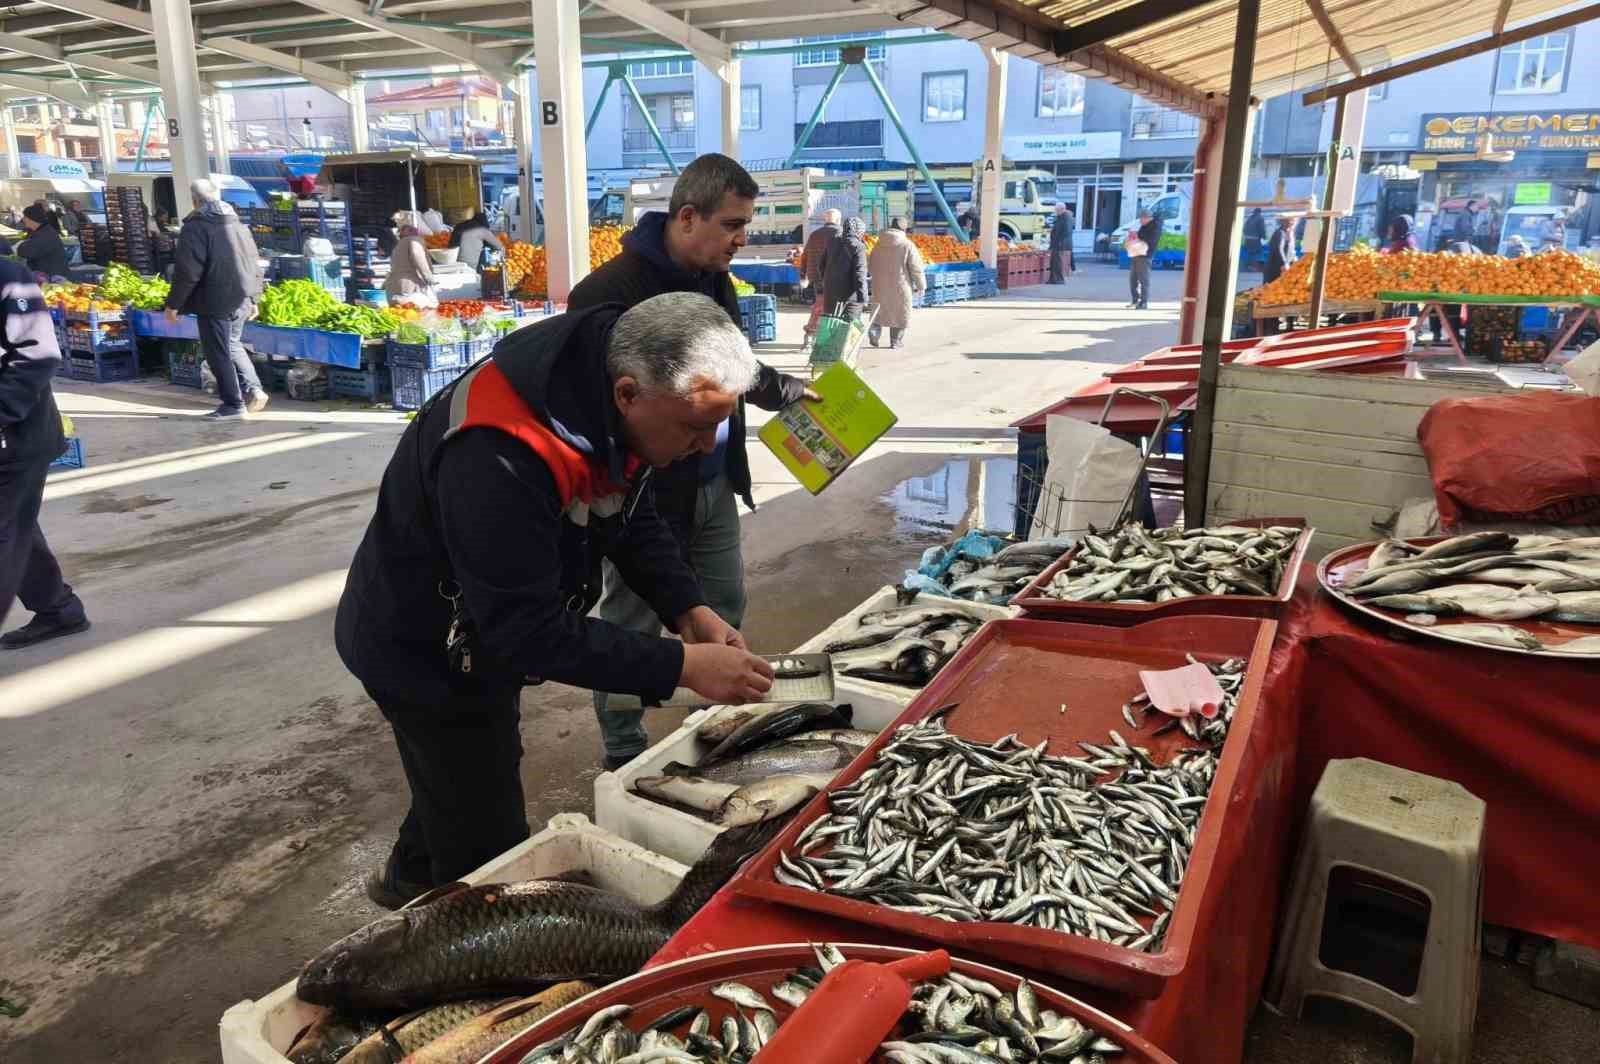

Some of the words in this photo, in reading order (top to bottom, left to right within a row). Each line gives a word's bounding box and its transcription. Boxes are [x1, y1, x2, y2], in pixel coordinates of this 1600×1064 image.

[543, 101, 558, 125] B
[168, 119, 179, 137] B
[1340, 146, 1353, 160] A
[985, 159, 994, 171] A
